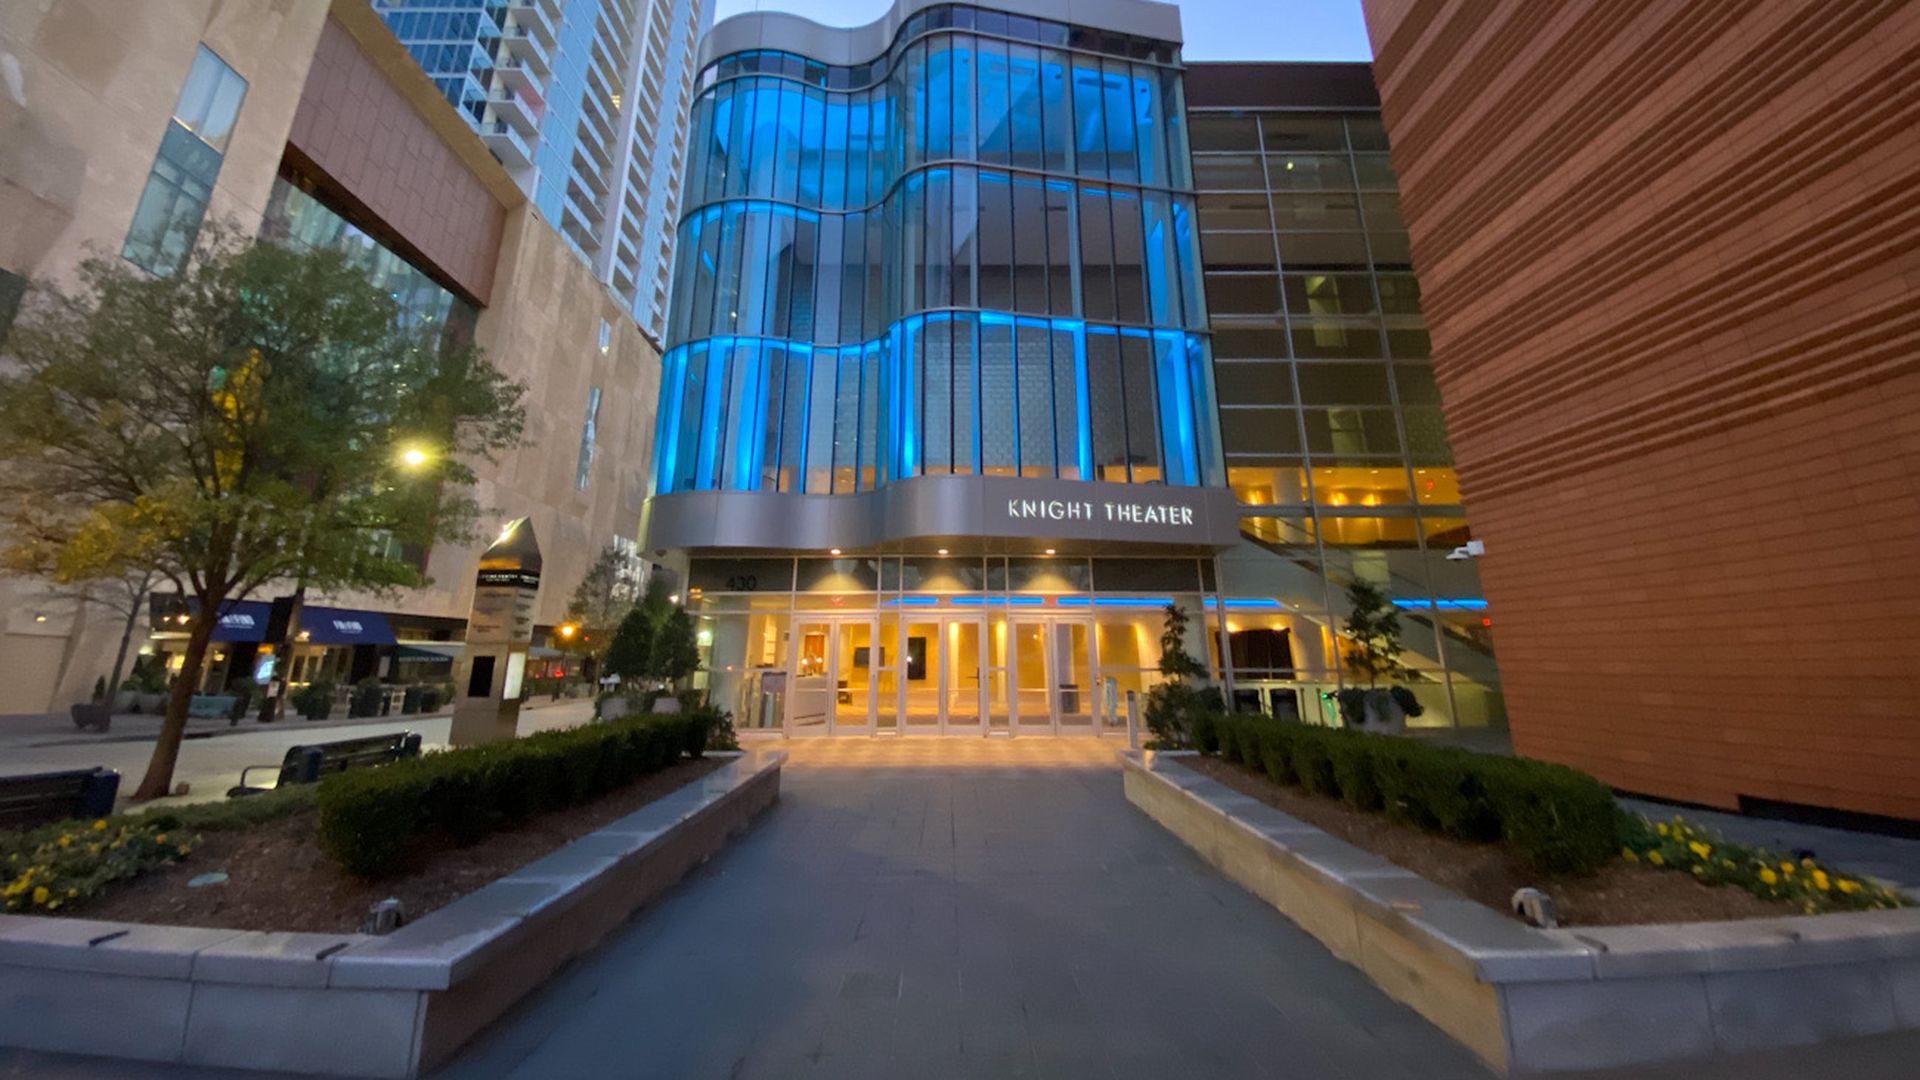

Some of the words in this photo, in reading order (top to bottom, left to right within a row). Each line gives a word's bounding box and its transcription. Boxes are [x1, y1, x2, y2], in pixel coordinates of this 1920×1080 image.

[1007, 499, 1094, 521] KNIGHT
[1103, 502, 1194, 526] THEATER
[725, 574, 758, 591] 430
